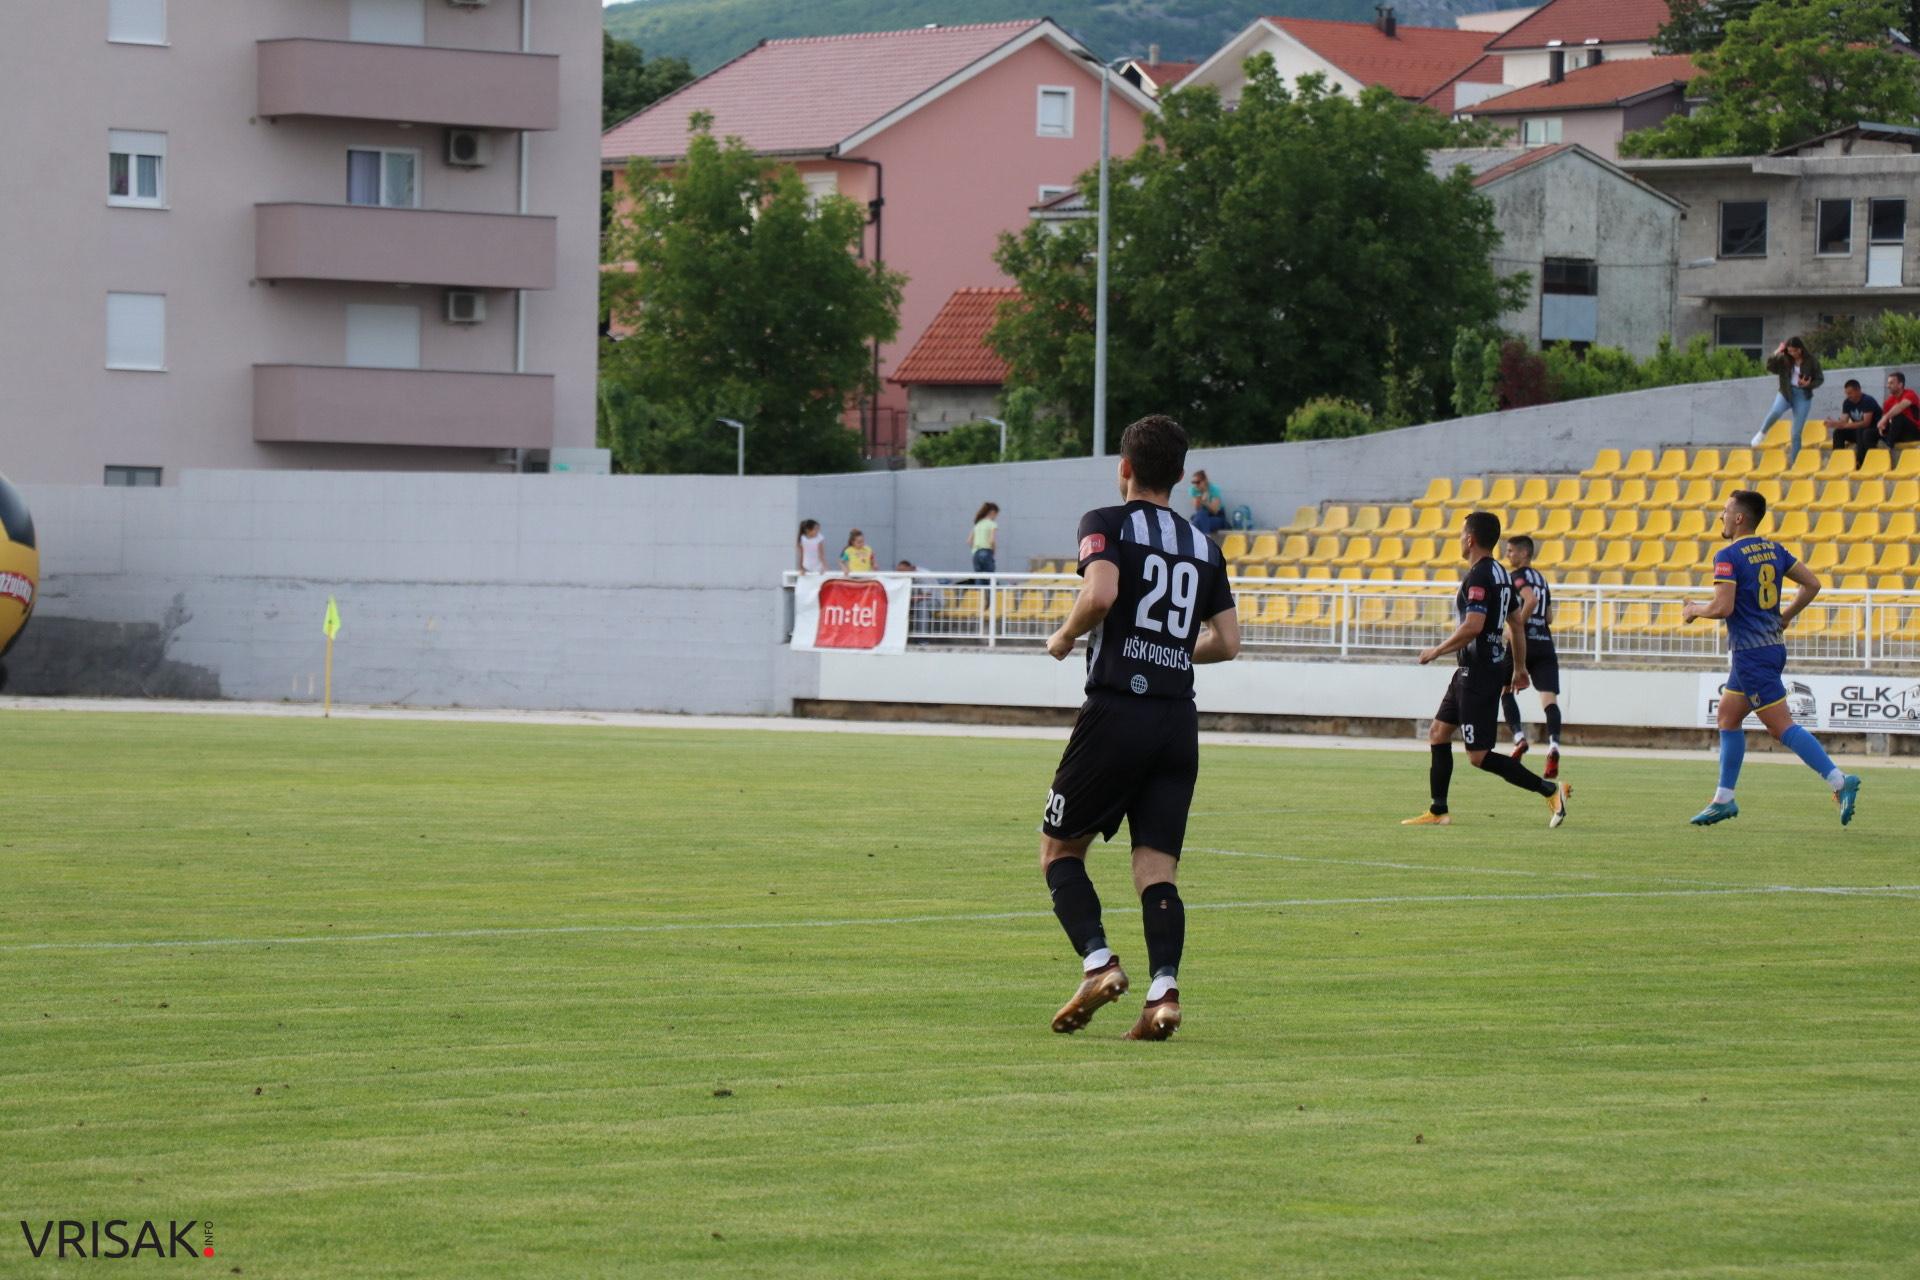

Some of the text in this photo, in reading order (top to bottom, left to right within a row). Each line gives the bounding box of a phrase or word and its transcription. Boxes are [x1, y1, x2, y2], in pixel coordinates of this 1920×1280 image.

[1135, 554, 1199, 639] 29
[1758, 563, 1778, 610] 8
[824, 599, 878, 627] m:tel
[1122, 635, 1149, 661] HŠK
[1840, 686, 1892, 702] GLK
[1830, 702, 1900, 719] PEPO
[1461, 723, 1475, 744] 13
[1043, 788, 1066, 828] 29
